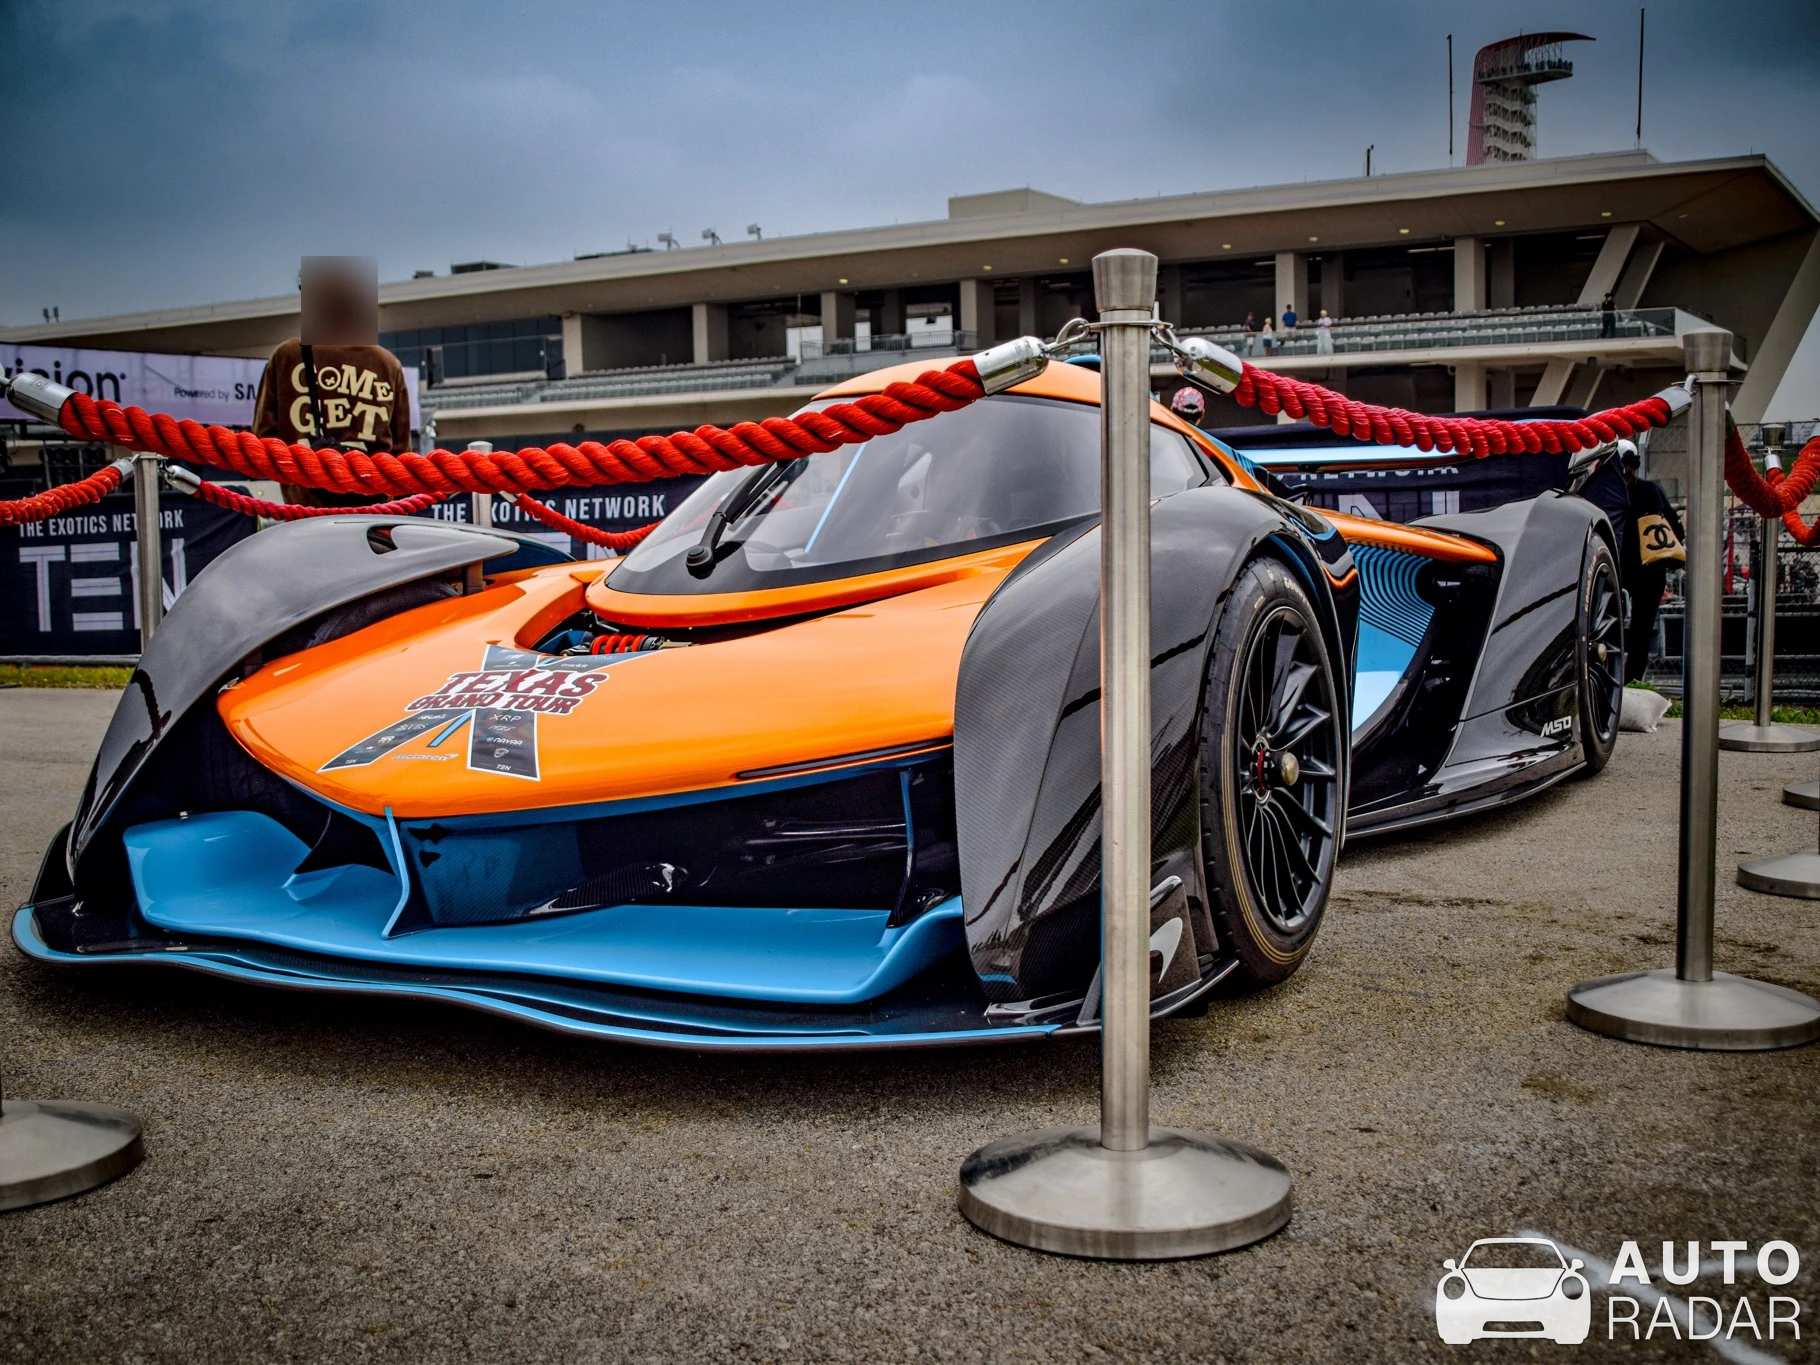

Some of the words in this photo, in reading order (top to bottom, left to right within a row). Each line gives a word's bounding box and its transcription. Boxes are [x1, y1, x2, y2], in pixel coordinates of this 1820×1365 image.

[174, 387, 215, 399] Powered
[217, 389, 230, 402] by
[291, 362, 394, 401] COME
[290, 395, 389, 441] GET
[432, 503, 467, 523] THE
[565, 494, 666, 520] NETWORK
[20, 520, 44, 537] THE
[49, 515, 107, 536] EXOTICS
[112, 509, 184, 532] NETRK
[437, 670, 608, 697] TEXAS
[407, 693, 504, 710] GRAND
[501, 694, 582, 714] TOUR
[488, 713, 522, 722] XRP
[496, 763, 512, 771] TEN
